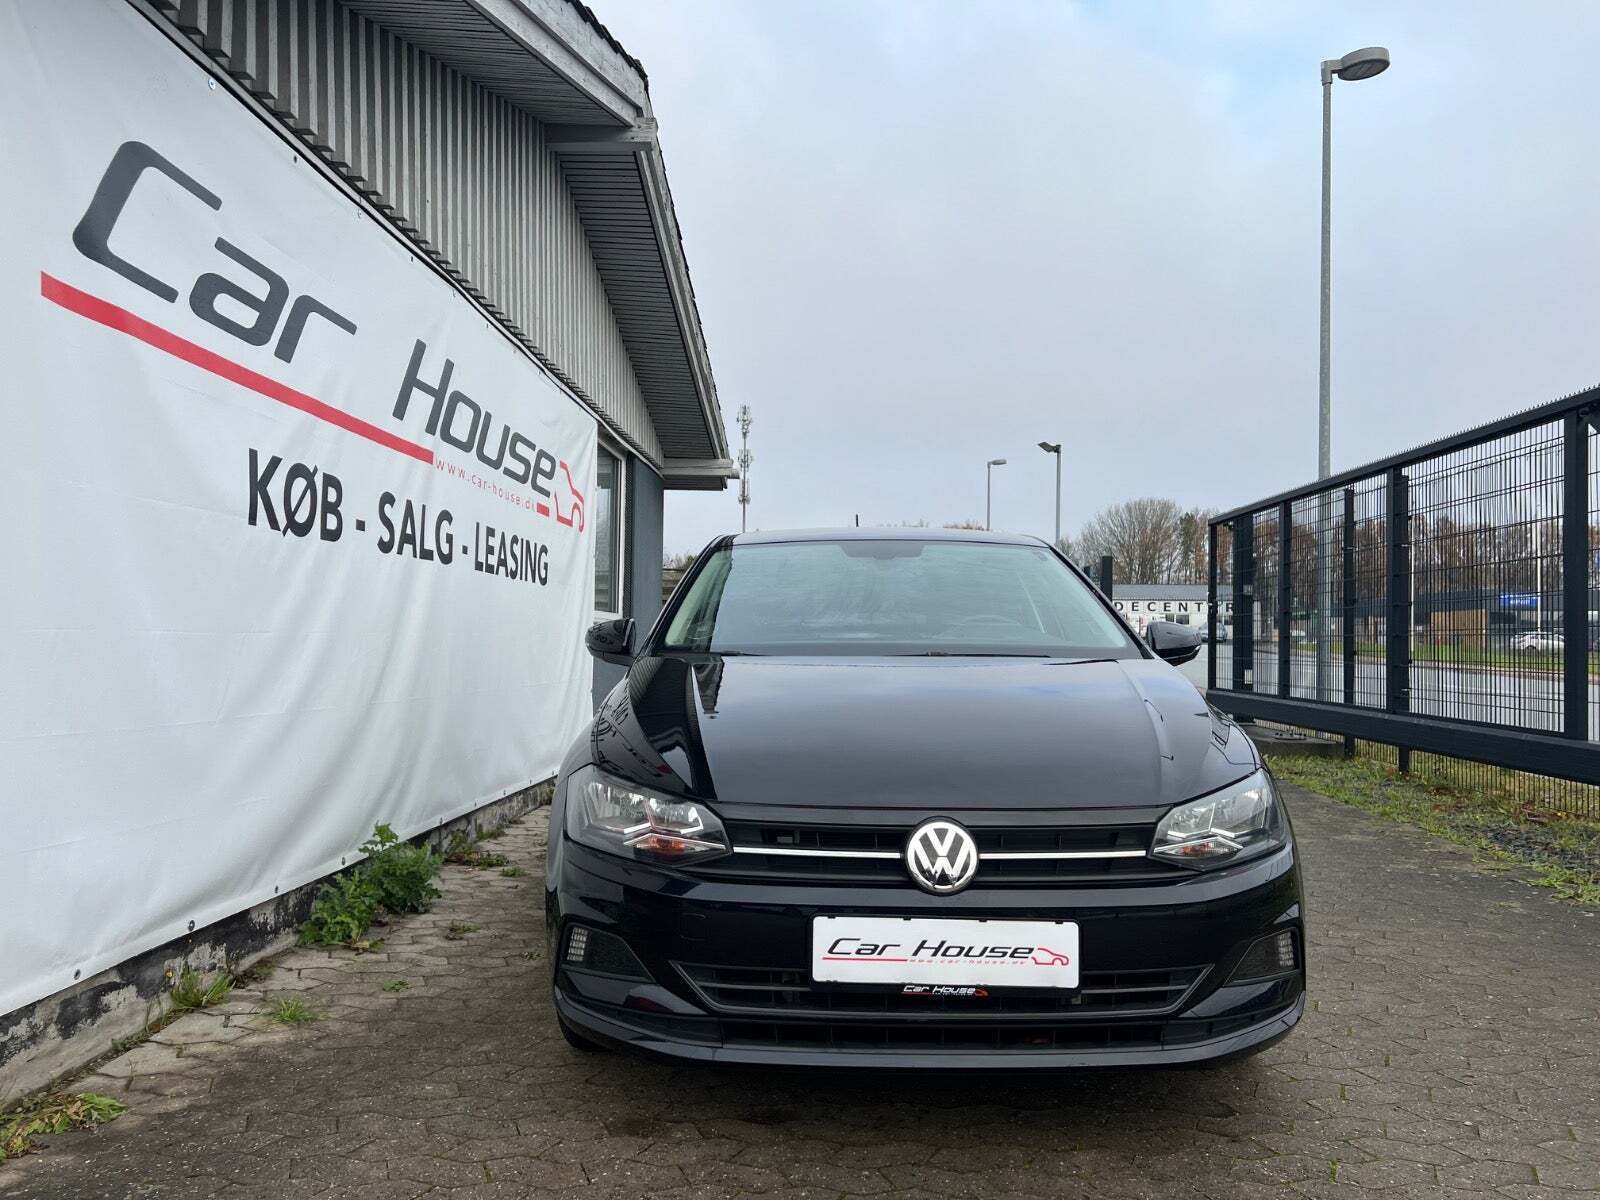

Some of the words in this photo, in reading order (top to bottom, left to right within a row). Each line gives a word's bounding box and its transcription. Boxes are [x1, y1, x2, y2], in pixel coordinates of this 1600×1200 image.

[72, 140, 358, 364] Car
[391, 338, 556, 498] House
[247, 447, 344, 543] KØB
[377, 491, 454, 566] SALG
[474, 521, 549, 587] LEASING
[1114, 601, 1233, 613] DECENTR
[827, 938, 901, 956] Car
[911, 940, 1035, 959] House
[903, 985, 930, 993] Car
[932, 985, 976, 994] House
